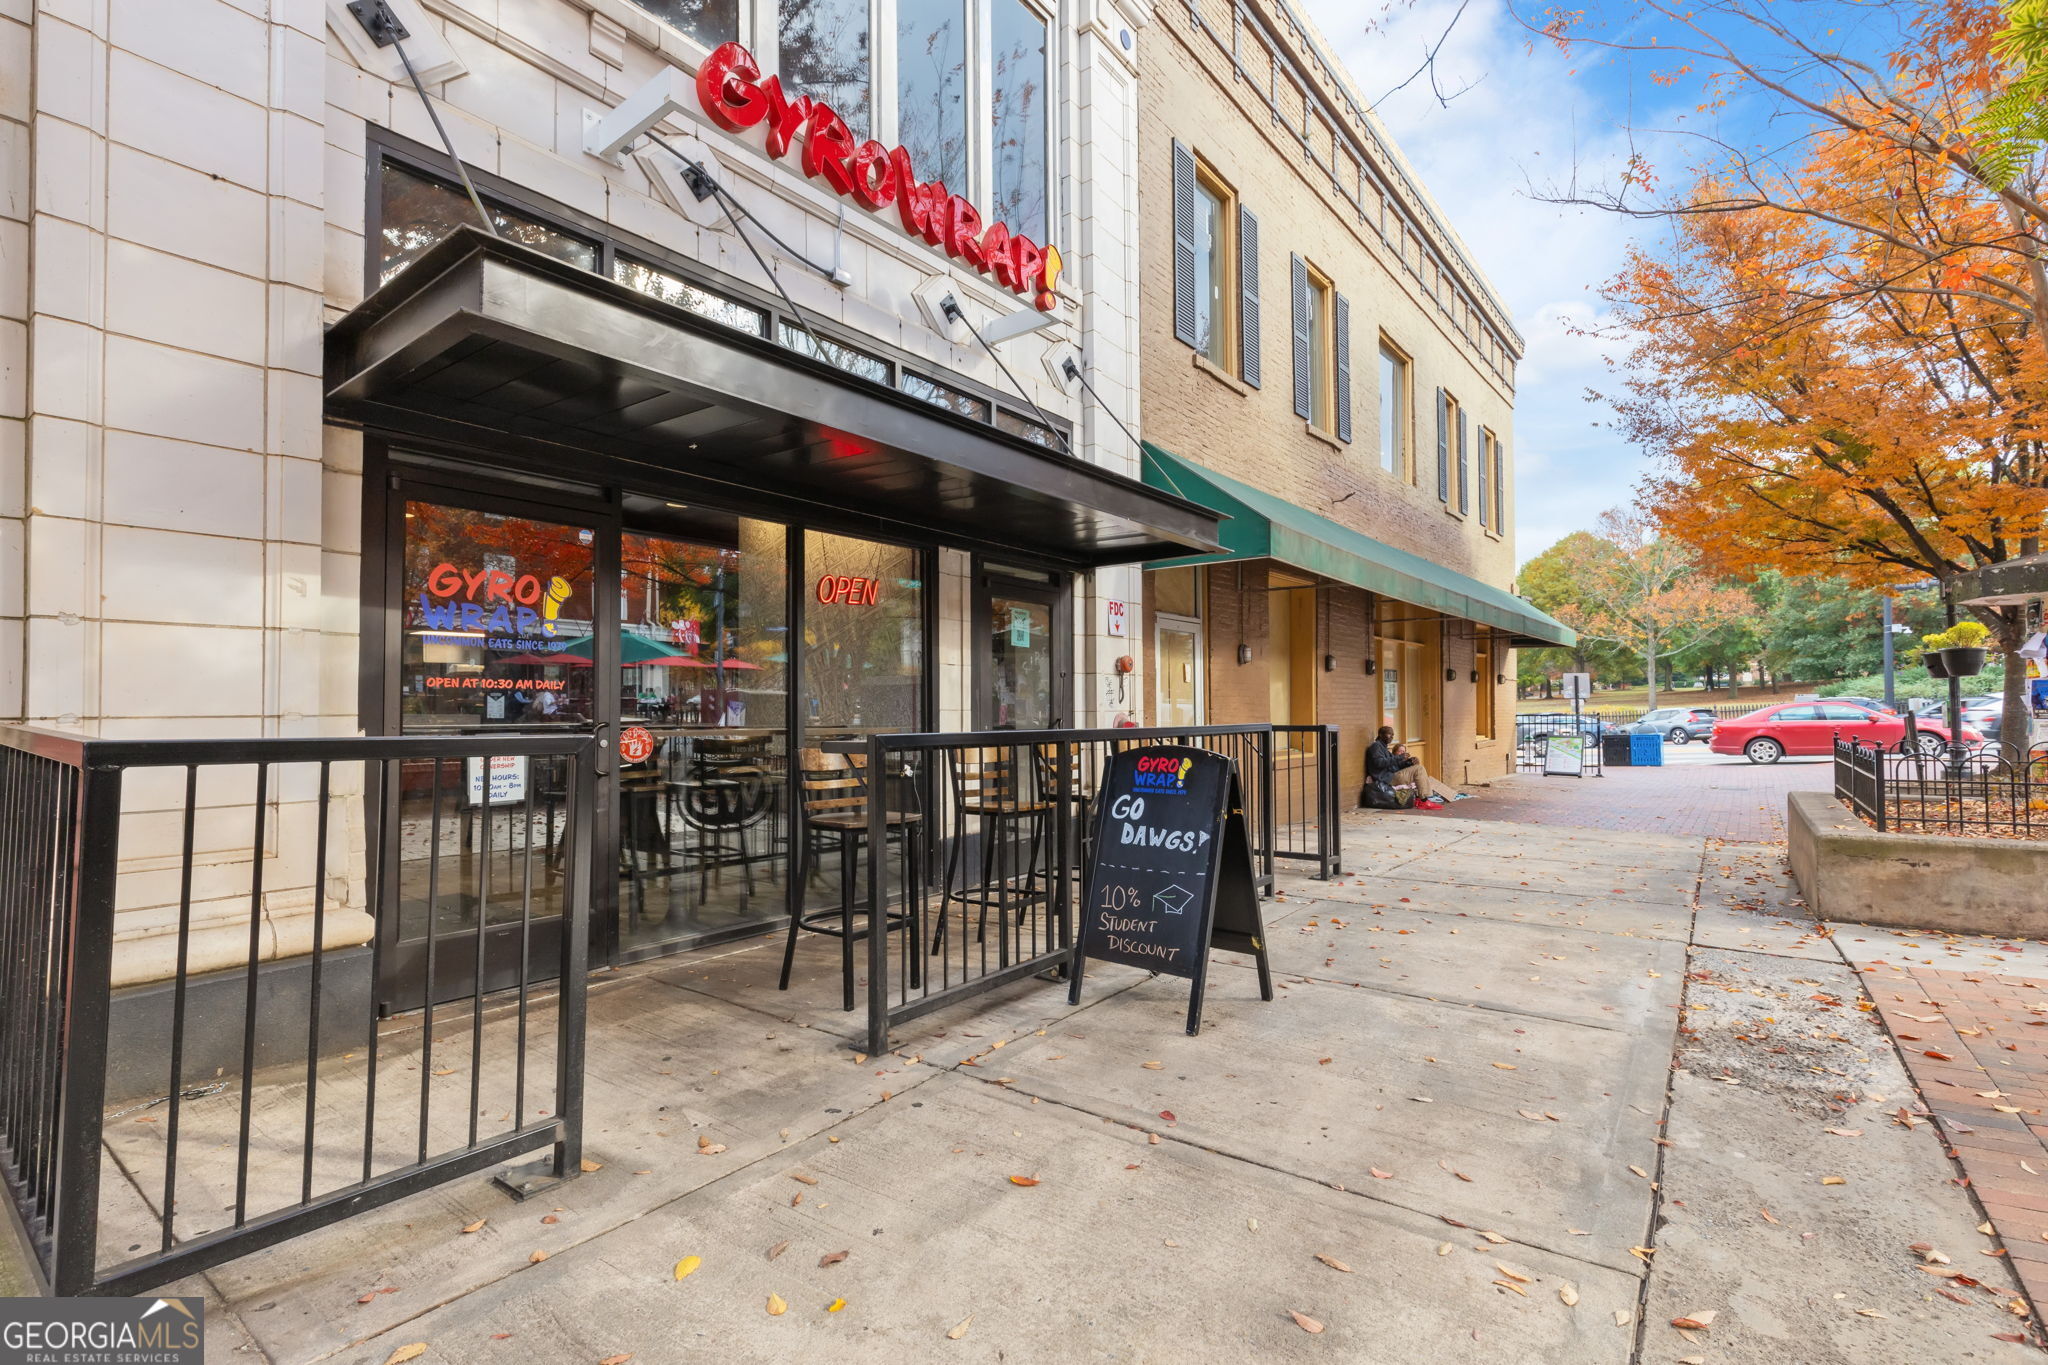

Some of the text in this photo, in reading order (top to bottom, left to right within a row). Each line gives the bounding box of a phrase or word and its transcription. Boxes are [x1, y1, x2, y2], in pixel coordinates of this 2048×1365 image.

[428, 563, 541, 605] GYRO
[816, 574, 880, 606] OPEN
[1109, 601, 1124, 617] FDC
[488, 638, 513, 650] EATS
[516, 640, 544, 651] SINCE
[426, 677, 566, 691] OPEN AT 10:30 AM DAILY
[1137, 756, 1180, 773] GYRO
[1111, 794, 1145, 821] GO
[1120, 821, 1211, 855] DAWGS!
[1100, 884, 1141, 911] 10%
[1098, 911, 1158, 933] STUDENT
[1107, 934, 1181, 962] DISCOUNT
